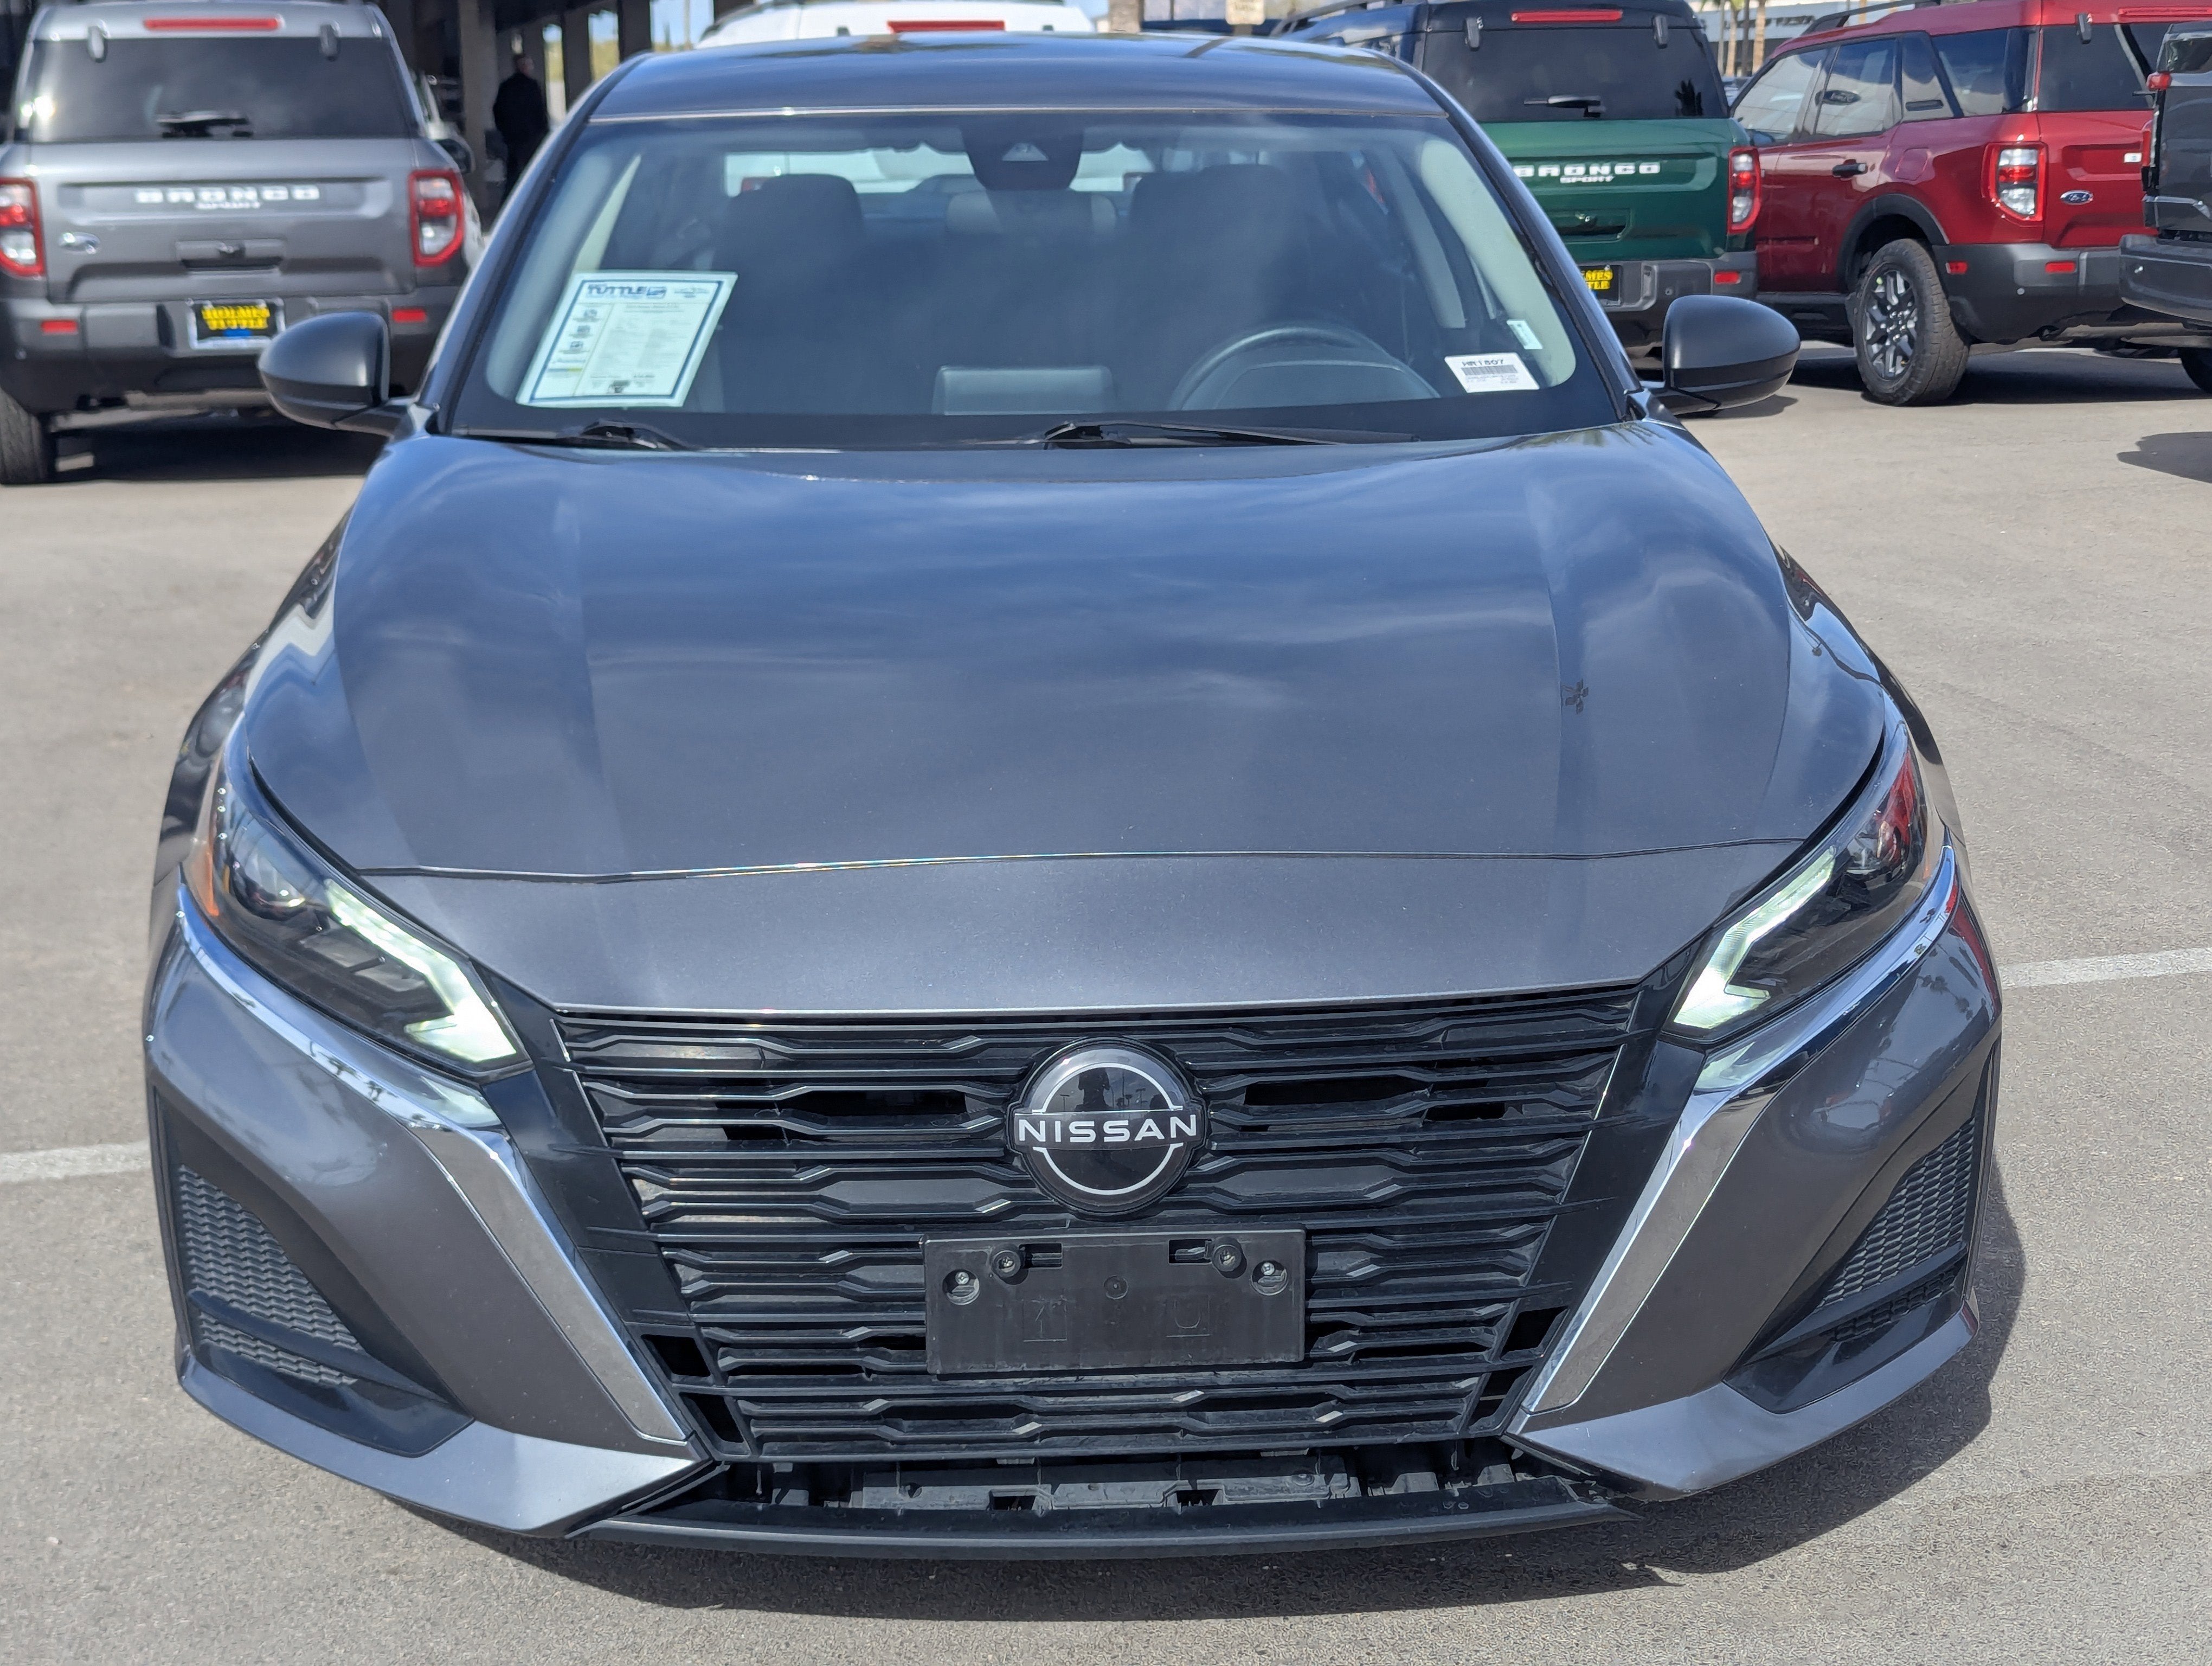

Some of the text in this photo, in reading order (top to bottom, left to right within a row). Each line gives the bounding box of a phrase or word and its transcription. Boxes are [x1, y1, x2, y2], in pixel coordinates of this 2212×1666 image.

[1513, 162, 1660, 177] BRONCO
[1560, 174, 1615, 183] SPORT
[134, 185, 320, 203] BRONCO
[587, 284, 647, 295] TUTTLE
[1019, 1114, 1197, 1143] NISSAN
